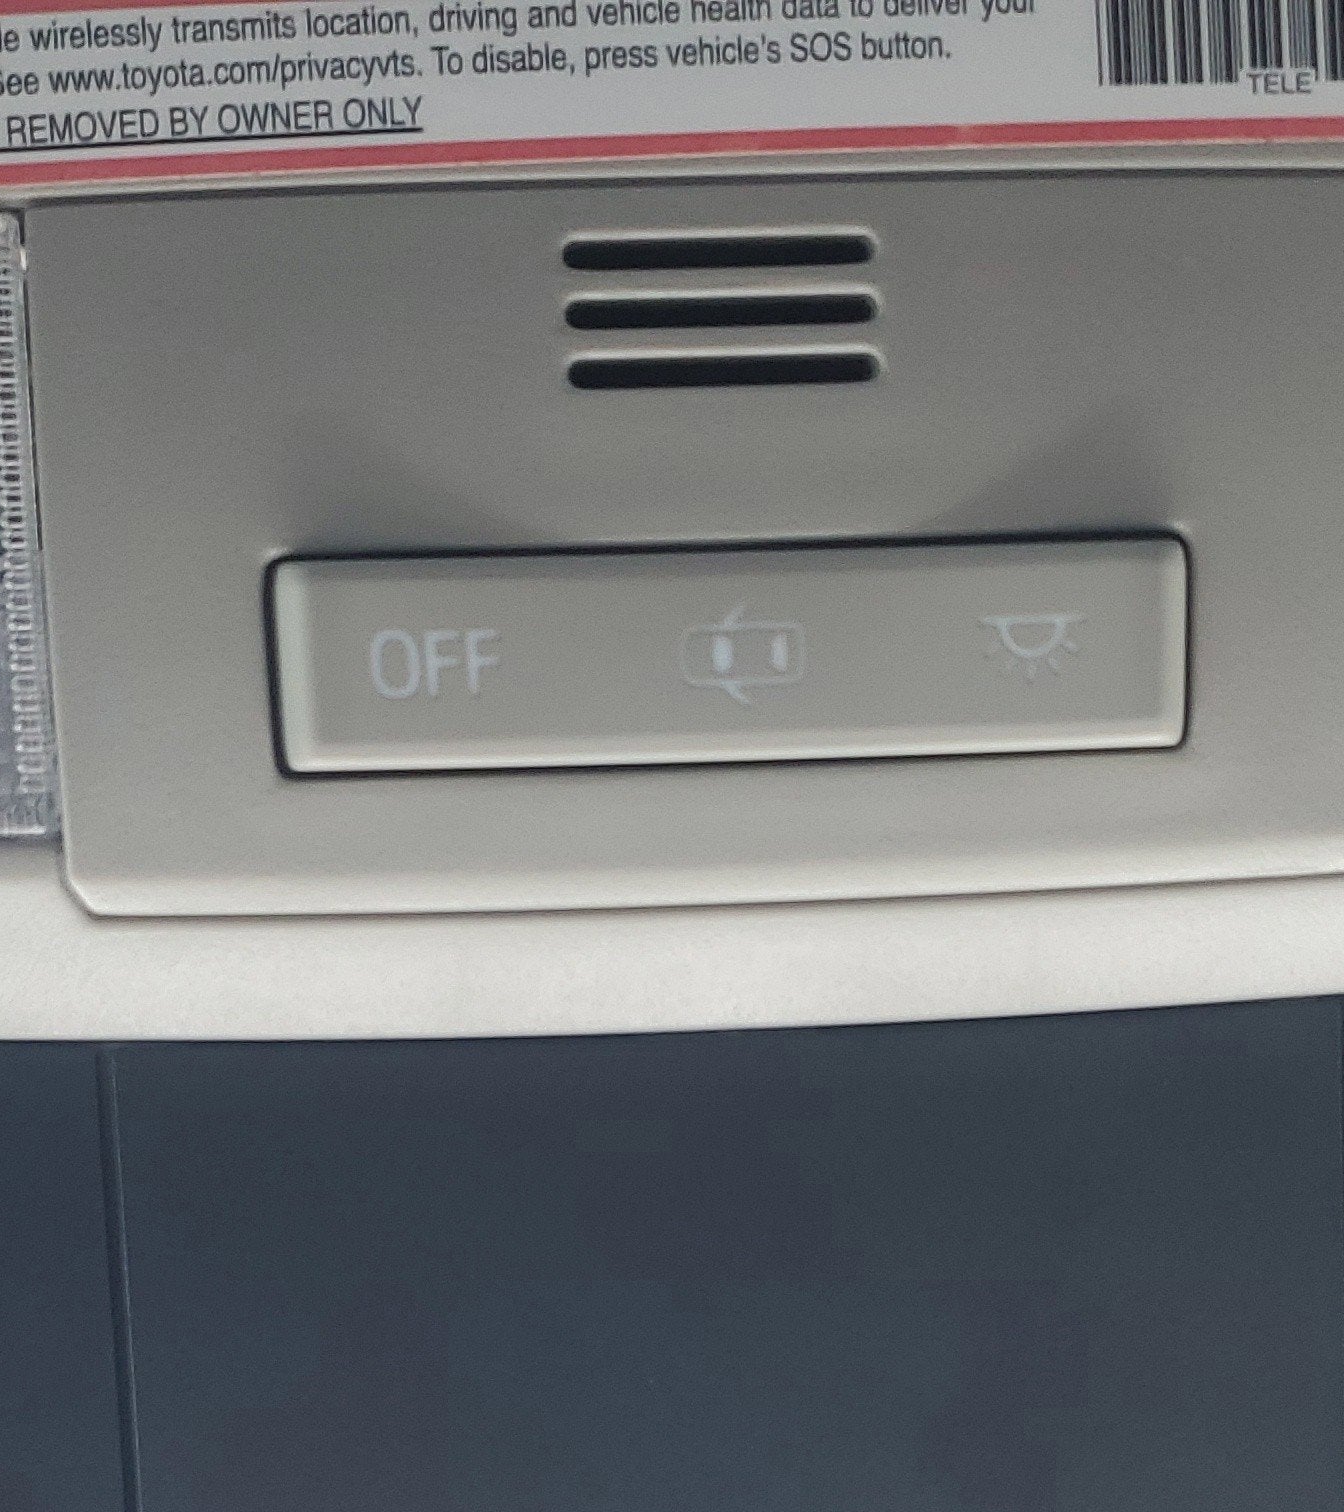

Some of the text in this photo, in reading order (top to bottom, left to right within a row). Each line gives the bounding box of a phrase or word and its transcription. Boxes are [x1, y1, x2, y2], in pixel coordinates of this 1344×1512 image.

[29, 16, 162, 52] wirelessly
[172, 11, 297, 43] transmits
[306, 5, 419, 38] location,
[429, 2, 517, 37] driving
[527, 0, 577, 28] and
[586, 0, 680, 27] vehicle
[48, 49, 423, 97] www.toyota.com/privacyvts.
[430, 45, 463, 75] To
[471, 41, 576, 76] disable,
[584, 43, 658, 77] press
[665, 35, 782, 67] vehicle's
[790, 31, 853, 63] SOS
[861, 30, 954, 60] button.
[1248, 71, 1312, 95] TELE
[6, 108, 160, 144] REMOVED
[168, 105, 208, 137] BY
[217, 100, 334, 134] OWNER
[342, 95, 422, 130] ONLY
[370, 629, 502, 699] OFF
